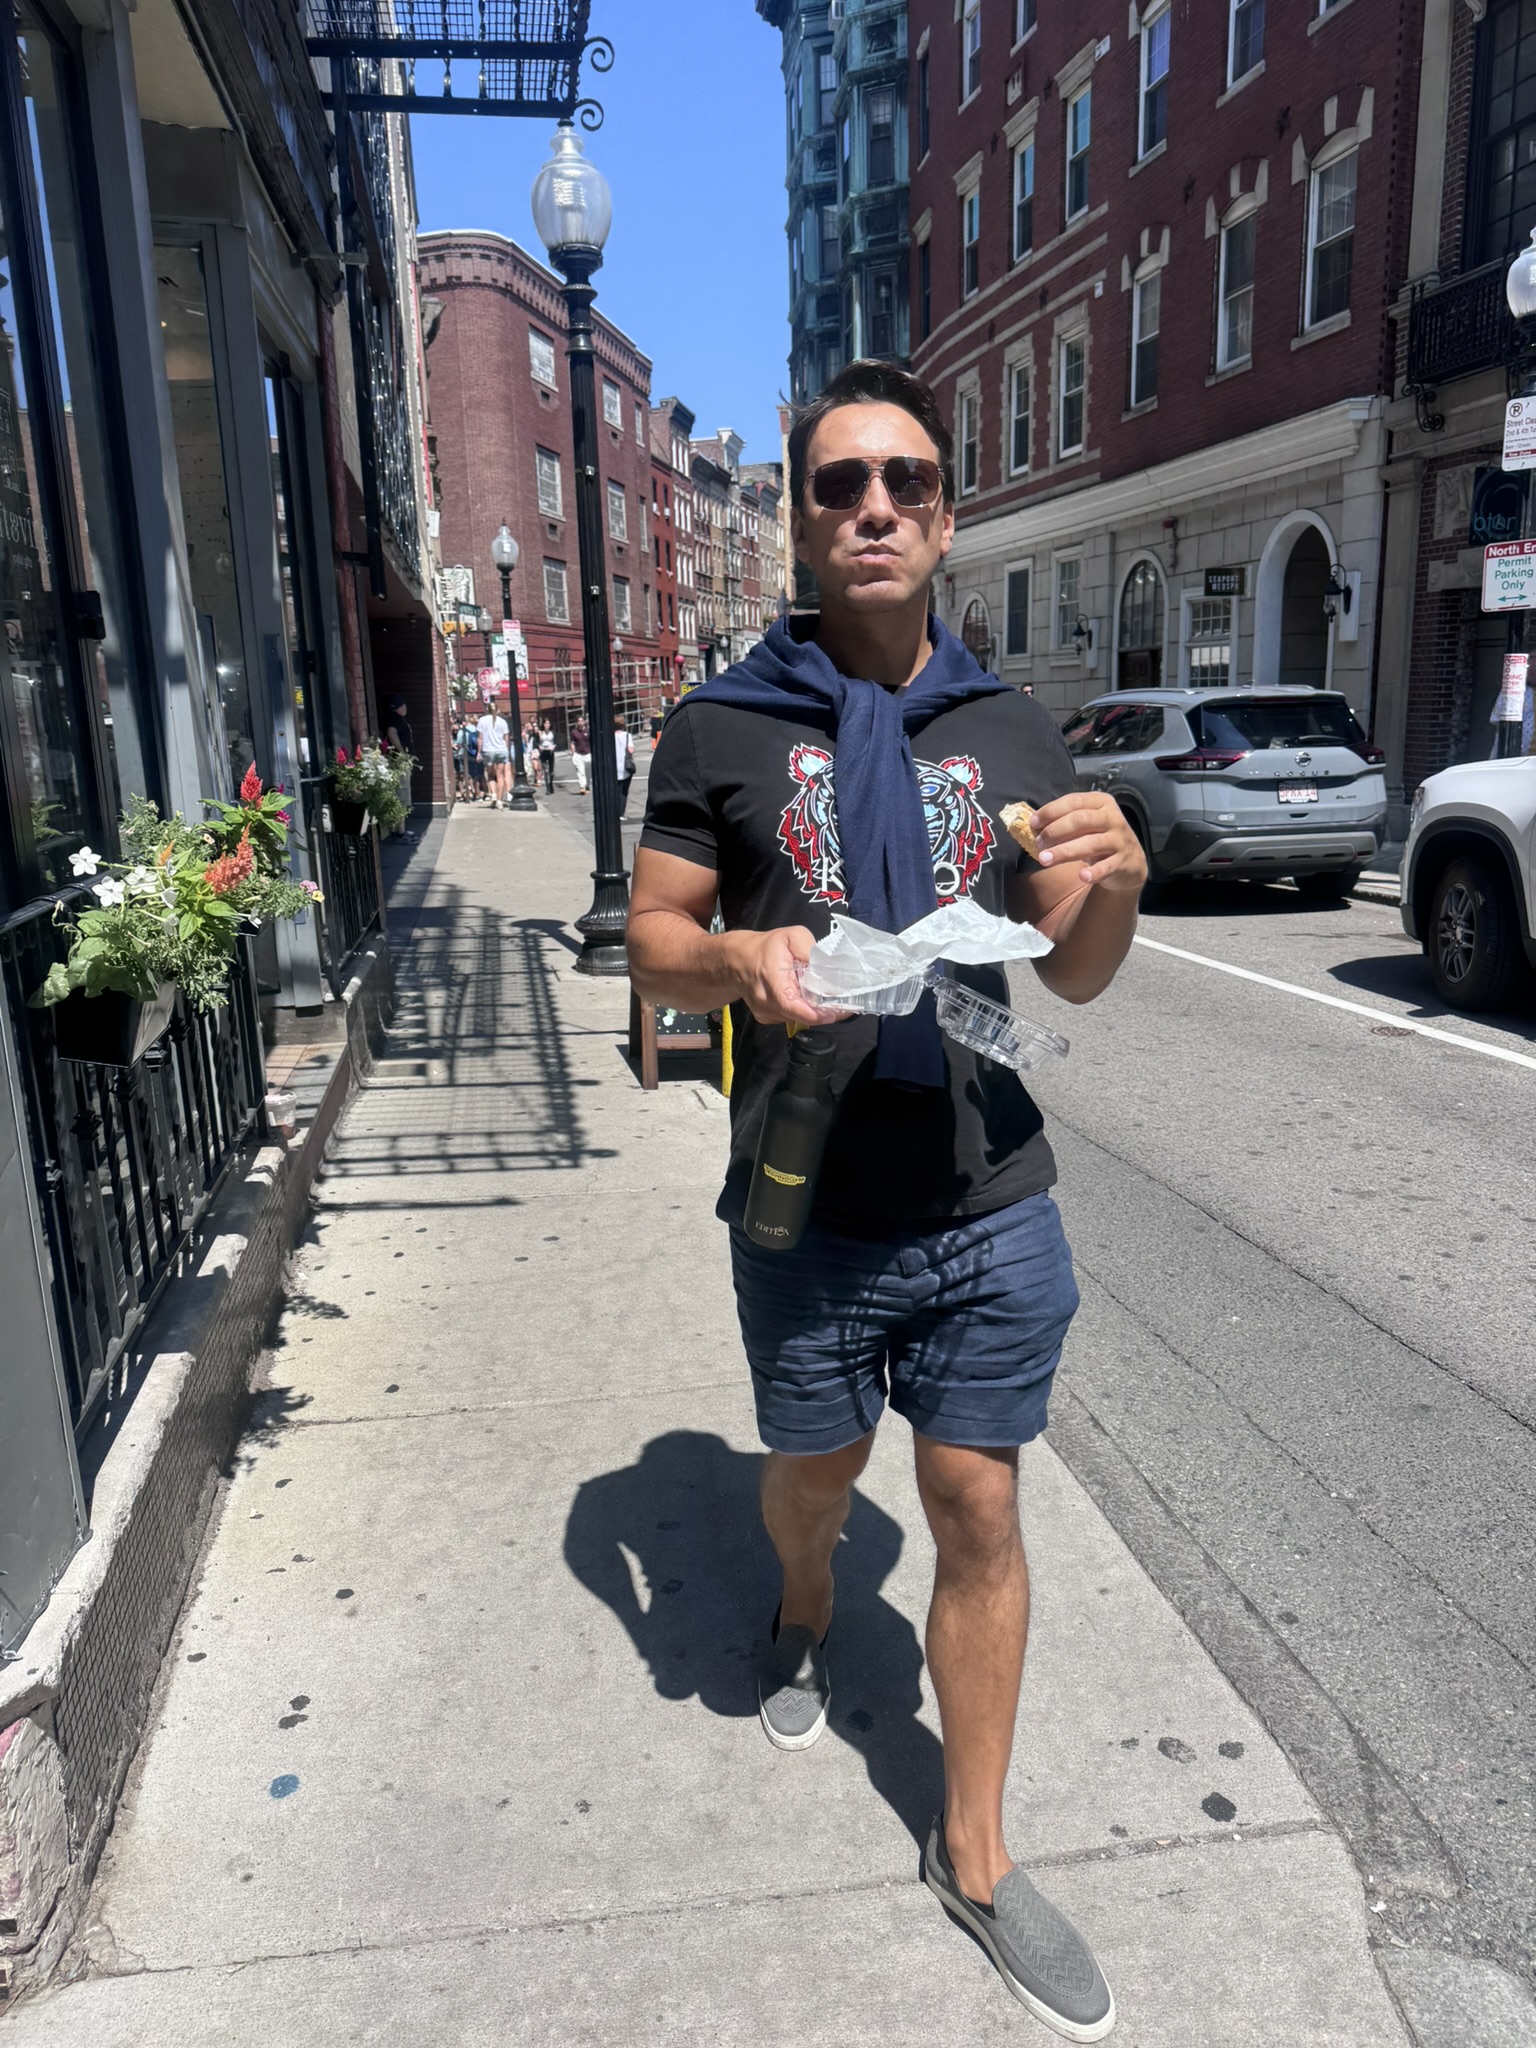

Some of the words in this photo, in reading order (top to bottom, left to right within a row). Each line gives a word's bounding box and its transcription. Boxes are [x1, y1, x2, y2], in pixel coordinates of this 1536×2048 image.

[1488, 544, 1520, 557] North
[1498, 556, 1532, 568] Permit
[1208, 575, 1239, 583] SEAPORT
[1494, 568, 1534, 579] Parking
[1501, 579, 1526, 591] Only
